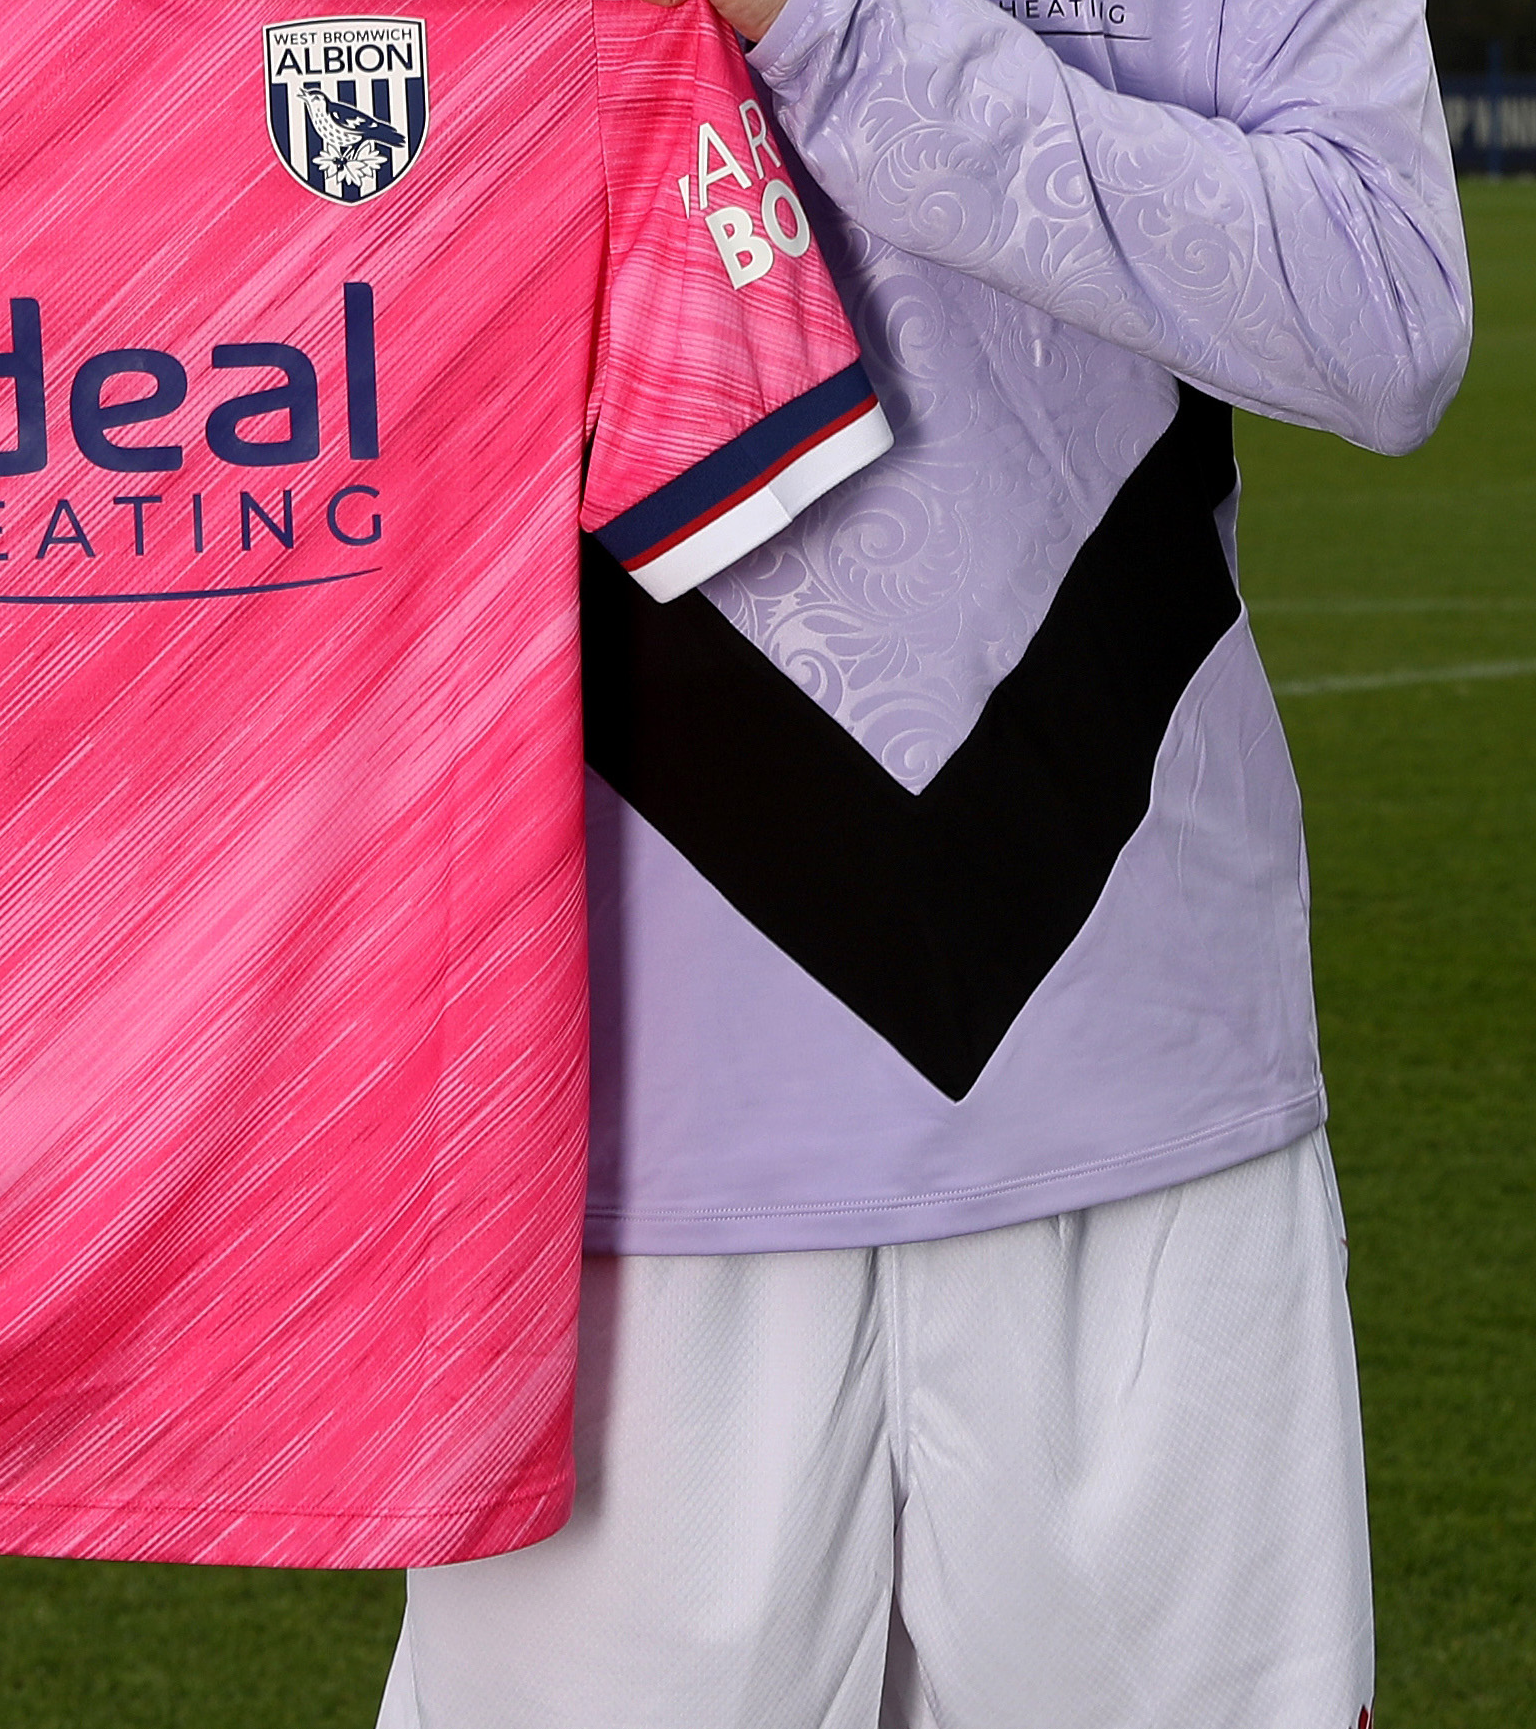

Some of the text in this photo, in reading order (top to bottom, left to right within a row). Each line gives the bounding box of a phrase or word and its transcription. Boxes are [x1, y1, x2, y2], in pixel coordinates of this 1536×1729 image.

[274, 28, 412, 45] WEST BROMWICH
[275, 43, 414, 77] ALBION
[705, 179, 811, 291] BO
